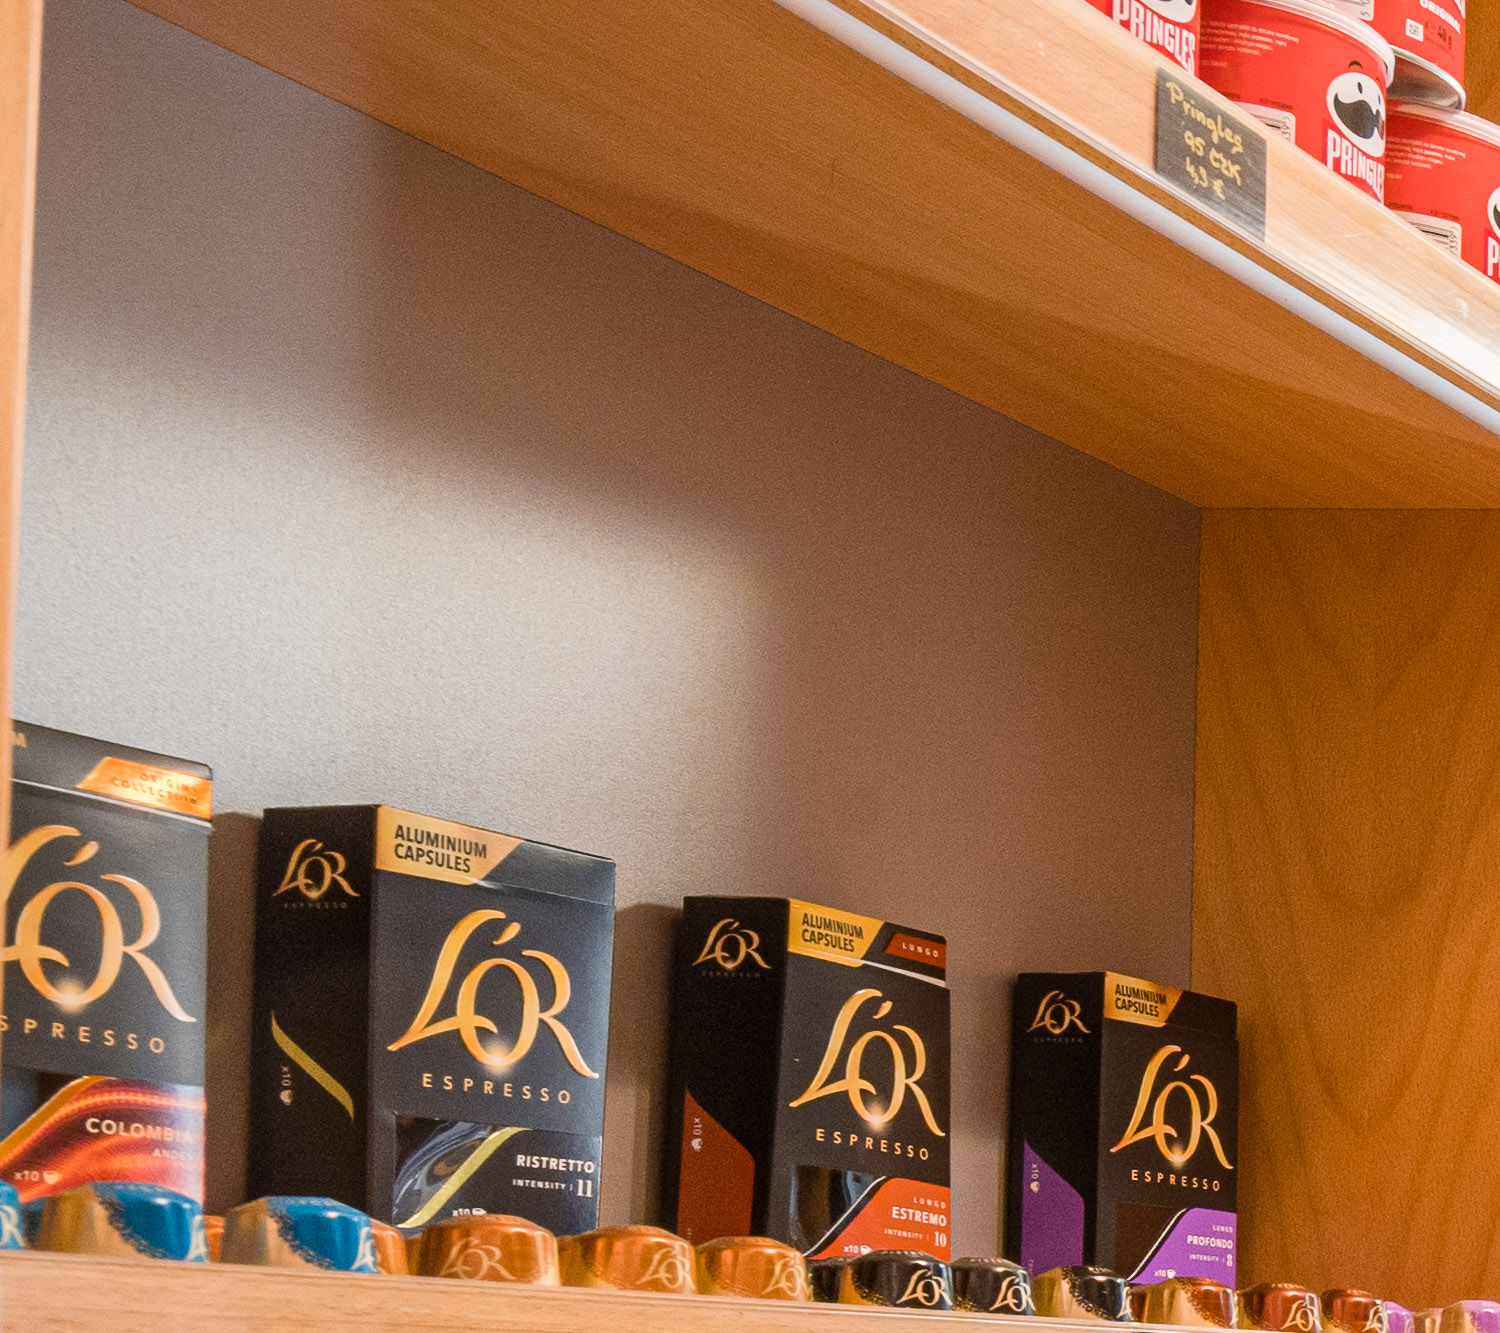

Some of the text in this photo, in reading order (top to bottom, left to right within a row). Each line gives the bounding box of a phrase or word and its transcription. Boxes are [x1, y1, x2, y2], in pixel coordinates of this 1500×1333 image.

[1112, 0, 1196, 72] PRINGLES
[1166, 81, 1244, 153] Pringles
[1184, 130, 1240, 186] 95 CZK
[394, 824, 488, 860] ALUMINIUM
[394, 843, 472, 874] CAPSULES
[802, 912, 864, 941] ALUMINIUM
[802, 929, 855, 954] CAPSULES
[422, 1073, 571, 1105] ESPRESSO
[86, 1116, 195, 1144] COLOMBIA
[816, 1128, 930, 1161] ESPRESSO
[516, 1153, 596, 1175] RISTRETTO
[1131, 1169, 1221, 1192] ESPRESSO
[892, 1206, 947, 1228] ESTREMO
[1187, 1235, 1233, 1250] PROFONDO
